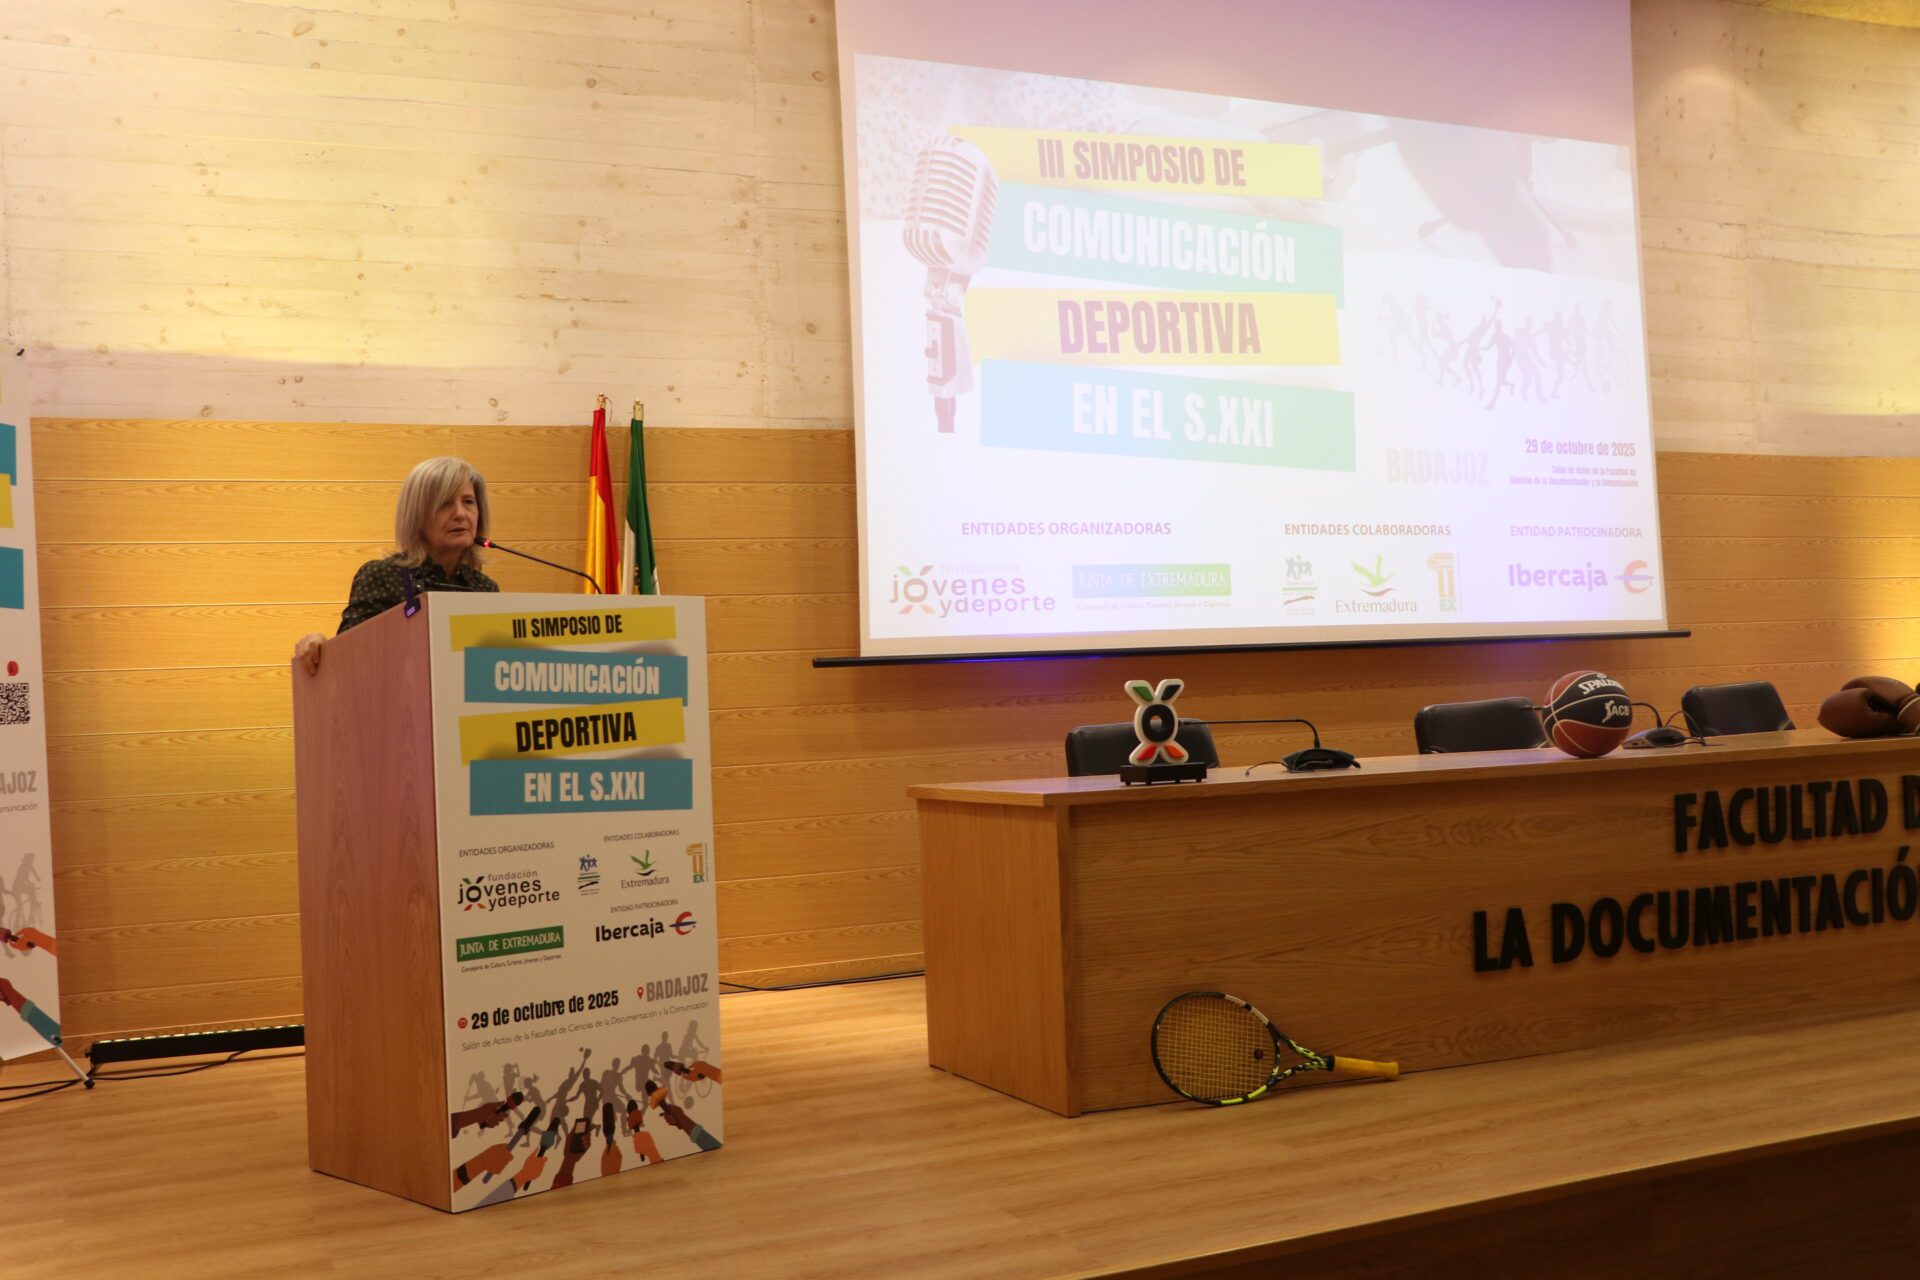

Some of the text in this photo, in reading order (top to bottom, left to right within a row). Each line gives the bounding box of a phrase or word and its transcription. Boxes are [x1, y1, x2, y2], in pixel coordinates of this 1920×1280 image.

[1037, 138, 1247, 187] III SIMPOSIO DE
[1022, 200, 1297, 284] COMUNICACIÓN
[1057, 300, 1262, 355] DEPORTIVA
[1072, 382, 1275, 448] EN EL S.XXI
[1525, 438, 1637, 457] 29 de octubre de 2025
[1386, 448, 1489, 484] BADAJOZ
[961, 522, 1172, 536] ENTIDADES ORGANIZADORAS
[1284, 523, 1452, 537] ENTIDADES COLABORADORAS
[1510, 526, 1643, 538] ENTIDAD PATROCINADORA
[939, 562, 1020, 574] fundación
[1508, 562, 1608, 592] Ibercaja
[889, 567, 1026, 604] jóvenes
[1077, 571, 1227, 591] JUNTA DE EXTREMADURA
[939, 595, 1056, 618] ydeporte
[1335, 598, 1418, 613] Extremadura
[512, 614, 623, 639] III SIMPOSIO DE
[494, 656, 660, 695] COMUNICACIÓN
[1611, 704, 1630, 716] ACB
[515, 712, 637, 752] DEPORTIVA
[524, 771, 645, 803] EN EL S.XXI
[1673, 777, 1889, 853] FACULTAD
[603, 829, 680, 842] ENTIDADES COLABORADORAS
[459, 841, 554, 857] ENTIDADES ORGANIZADORAS
[487, 869, 538, 881] fundación
[620, 876, 670, 889] Extremadura
[457, 876, 542, 904] jóvenes
[488, 891, 561, 911] ydeporte
[610, 899, 679, 913] ENTIDAD PATROCINADORA
[1473, 845, 1920, 973] LA DOCUMENTACIÓ
[595, 917, 664, 942] Ibercaja
[460, 932, 562, 957] JUNTA DE EXTREMADURA
[646, 973, 709, 1002] BADAJOZ
[471, 990, 619, 1030] 29 de octubre de 2025
[462, 1041, 480, 1051] Salón
[482, 1039, 491, 1048] de
[493, 1036, 512, 1046] Actos
[513, 1033, 522, 1042] de
[524, 1031, 530, 1040] la
[531, 1027, 558, 1039] Facultad
[558, 1024, 567, 1034] de
[568, 1021, 594, 1033] Ciencias
[595, 1019, 603, 1028] de
[604, 1017, 610, 1026] la
[611, 1010, 658, 1025] Documentación
[664, 1007, 669, 1016] la
[670, 1001, 709, 1014] Comunicación
